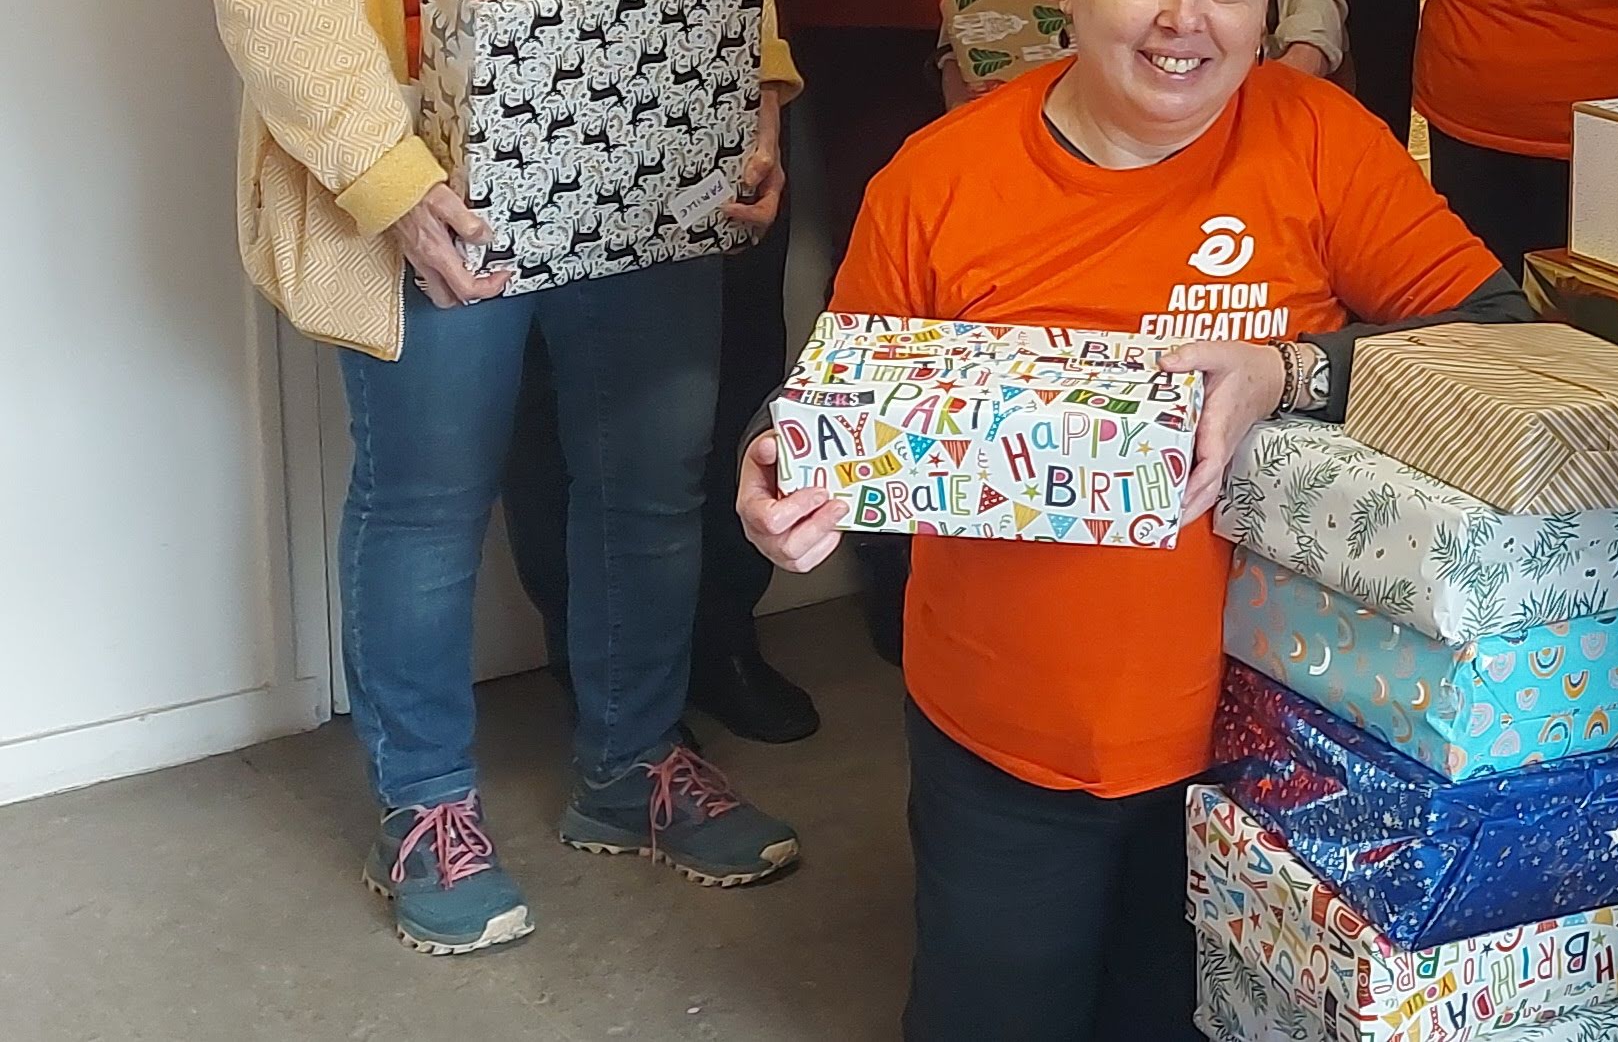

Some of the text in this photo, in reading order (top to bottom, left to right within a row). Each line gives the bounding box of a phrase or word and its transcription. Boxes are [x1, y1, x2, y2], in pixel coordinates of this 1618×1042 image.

[1168, 281, 1268, 312] ACTION
[1139, 307, 1289, 342] EDUCATION
[880, 382, 1024, 442] PARTY
[839, 454, 896, 484] YOU!
